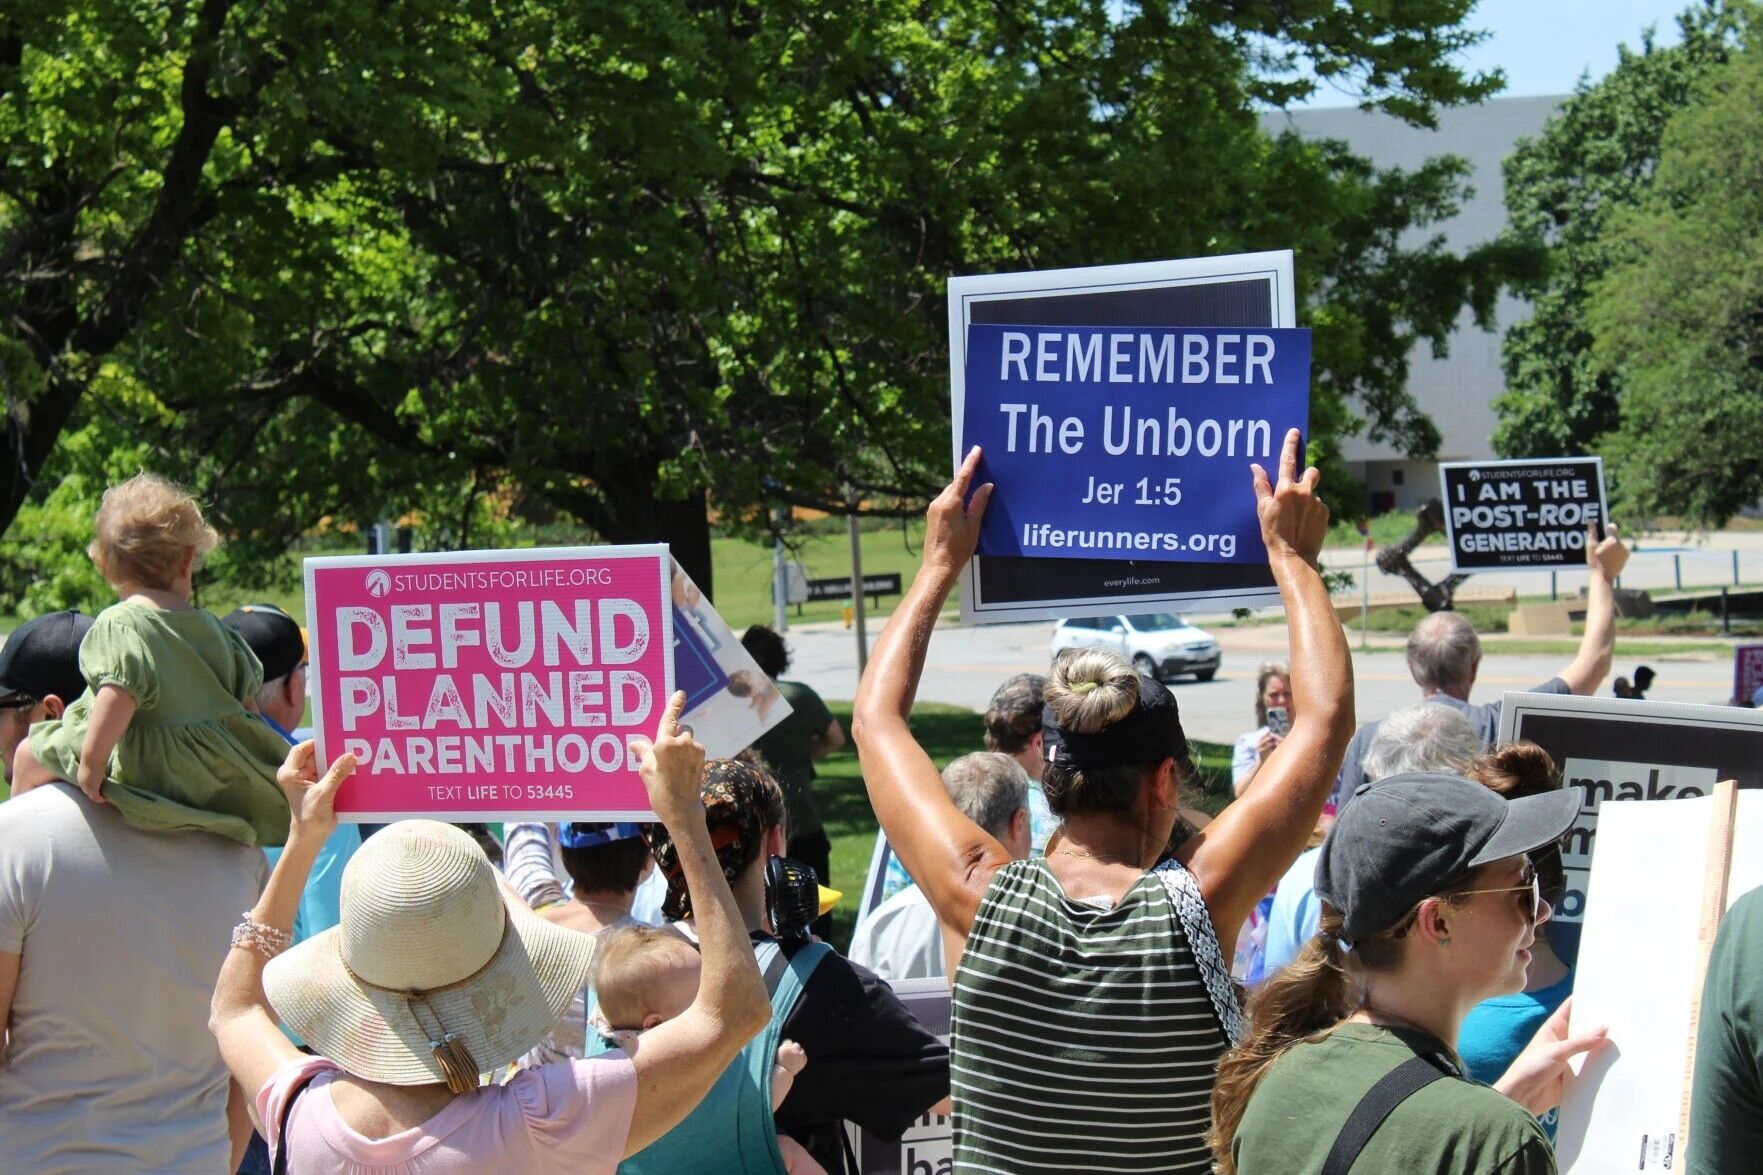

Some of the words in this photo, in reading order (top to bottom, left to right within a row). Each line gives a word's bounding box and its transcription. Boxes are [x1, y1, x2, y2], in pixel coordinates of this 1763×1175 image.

[1000, 331, 1276, 385] REMEMBER
[1000, 403, 1085, 455] The
[1103, 405, 1271, 458] Unborn
[1082, 476, 1124, 504] Jer
[1135, 478, 1182, 506] 1:5
[1457, 484, 1465, 502] I
[1478, 482, 1521, 501] AM
[1533, 479, 1588, 499] THE
[1452, 502, 1600, 528] POST-ROE
[1023, 523, 1236, 558] liferunners.org
[395, 567, 612, 592] STUDENTSFORLIFE.ORG
[1103, 577, 1161, 588] everylife.com
[335, 598, 651, 672] DEFUND
[339, 670, 653, 732] PLANNED
[428, 786, 463, 800] TEXT
[467, 786, 498, 800] LIFE
[502, 785, 523, 799] TO
[527, 785, 574, 799] 53445
